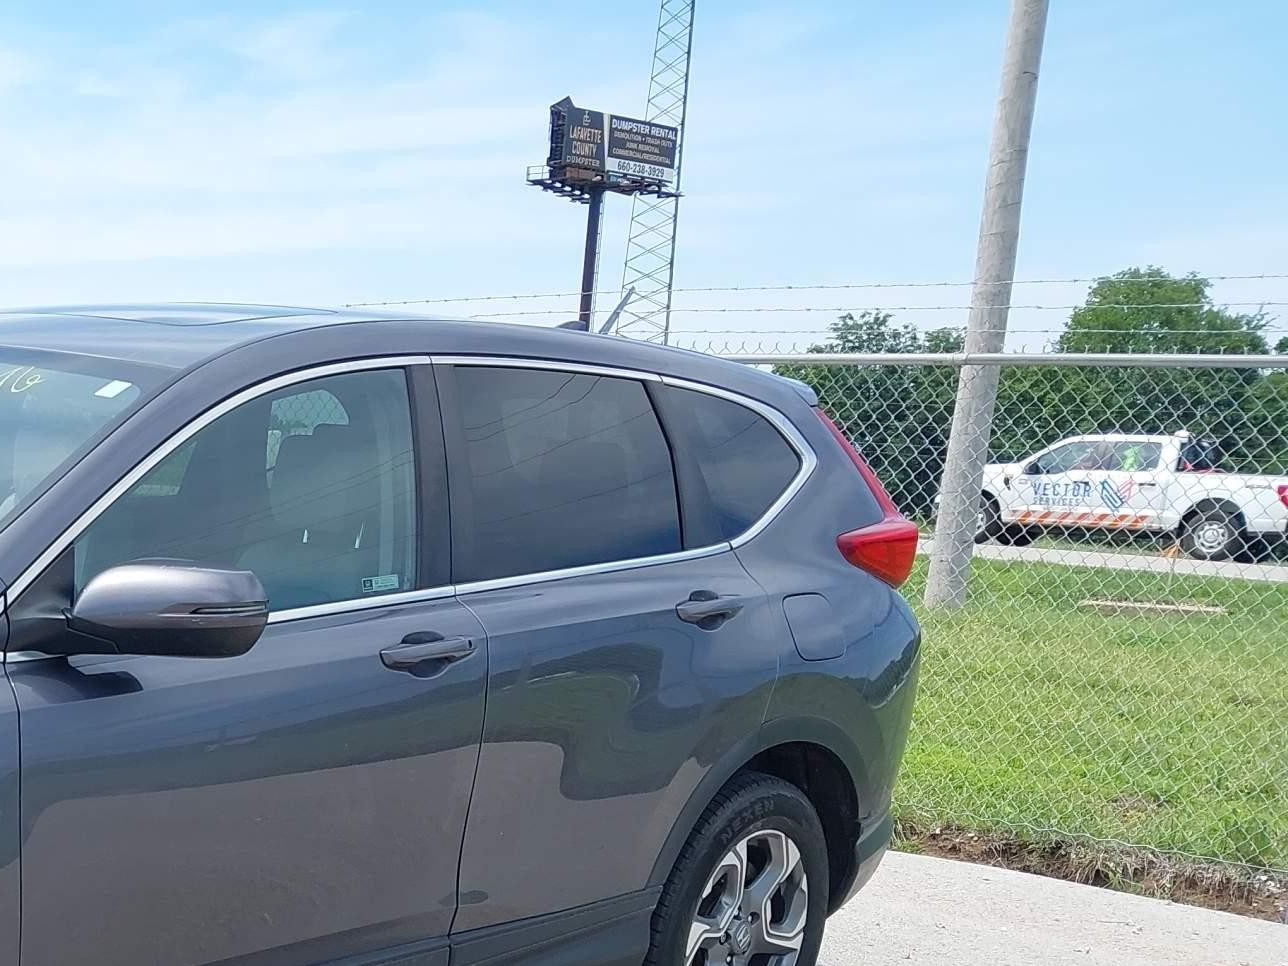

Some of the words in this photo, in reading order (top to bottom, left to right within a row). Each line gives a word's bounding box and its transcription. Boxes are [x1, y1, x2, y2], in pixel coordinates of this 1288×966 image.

[569, 125, 602, 143] LAFAYETTE
[611, 118, 650, 135] DUMPSTER
[650, 127, 676, 140] RENTAL
[572, 141, 597, 157] COUNTY
[567, 155, 600, 167] DUMPSTER
[617, 160, 665, 179] 660-238-3929
[1032, 481, 1091, 498] VECTOR
[1032, 496, 1080, 507] SERVICES
